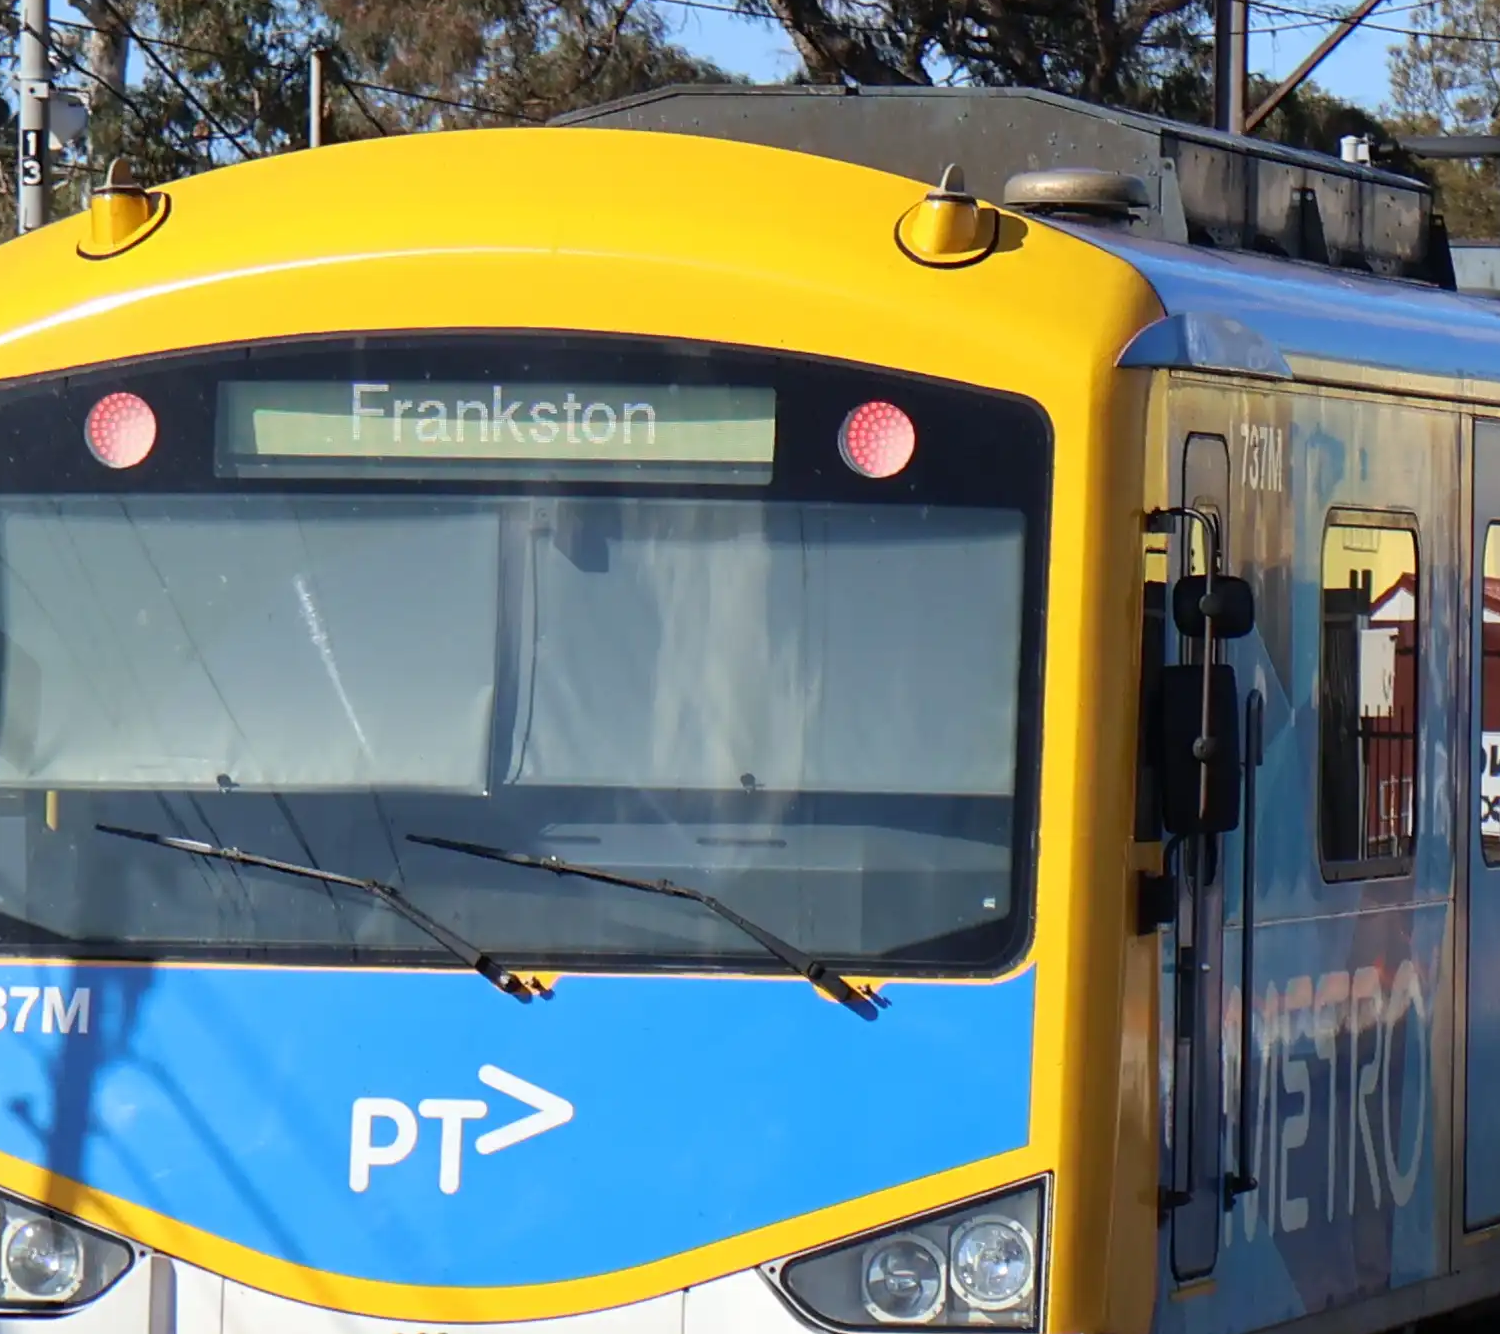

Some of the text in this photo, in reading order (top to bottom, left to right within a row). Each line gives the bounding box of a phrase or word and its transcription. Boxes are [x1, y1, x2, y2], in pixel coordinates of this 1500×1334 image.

[23, 132, 41, 185] 13
[352, 383, 657, 445] Frankston
[1240, 423, 1283, 493] 737M
[1222, 959, 1427, 1249] METRO
